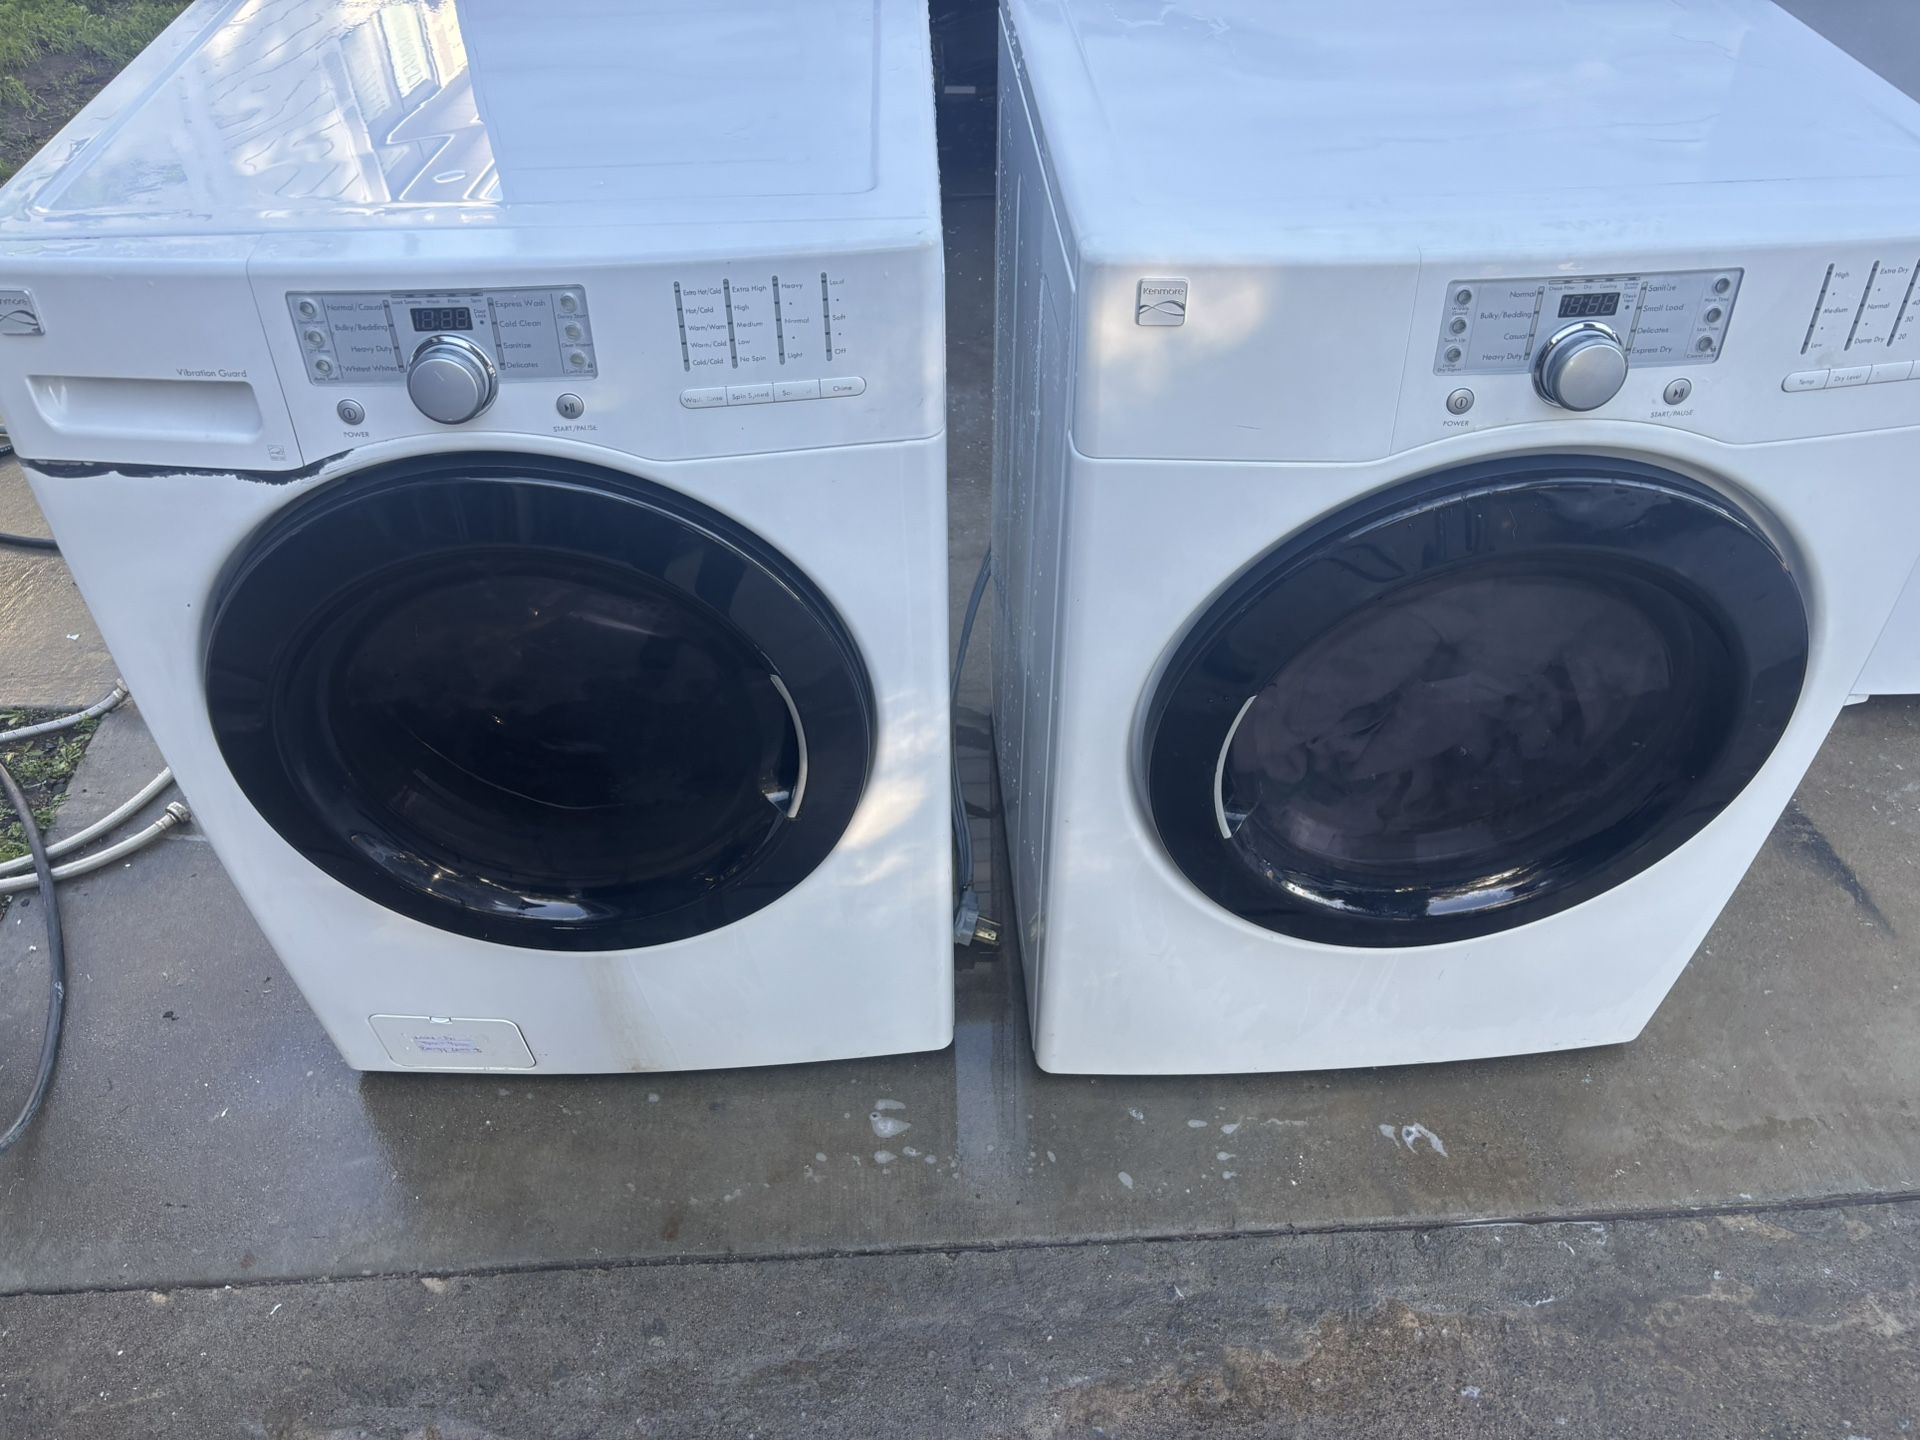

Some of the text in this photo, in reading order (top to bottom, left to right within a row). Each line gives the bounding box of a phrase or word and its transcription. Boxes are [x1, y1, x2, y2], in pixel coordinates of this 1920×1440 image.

[1898, 266, 1909, 274] Dry
[698, 287, 722, 295] Hot/Cold
[1143, 287, 1184, 295] Kenmore
[1648, 283, 1676, 292] Sanitize
[1509, 290, 1536, 298] Normal
[0, 298, 28, 306] more
[495, 299, 545, 309] Express Wash
[734, 304, 750, 312] High
[1643, 303, 1684, 312] Small Load
[1480, 311, 1532, 320] Bulky/Bedding
[335, 323, 388, 332] Bulky/Bedding
[1637, 327, 1669, 335] Delicates
[351, 345, 392, 354] Heavy Duty
[1632, 345, 1672, 355] Express Dry
[1507, 353, 1522, 361] Duty
[176, 369, 247, 377] Vibration Guard
[732, 393, 746, 401] Spin
[1651, 410, 1694, 418] START/PAUSE
